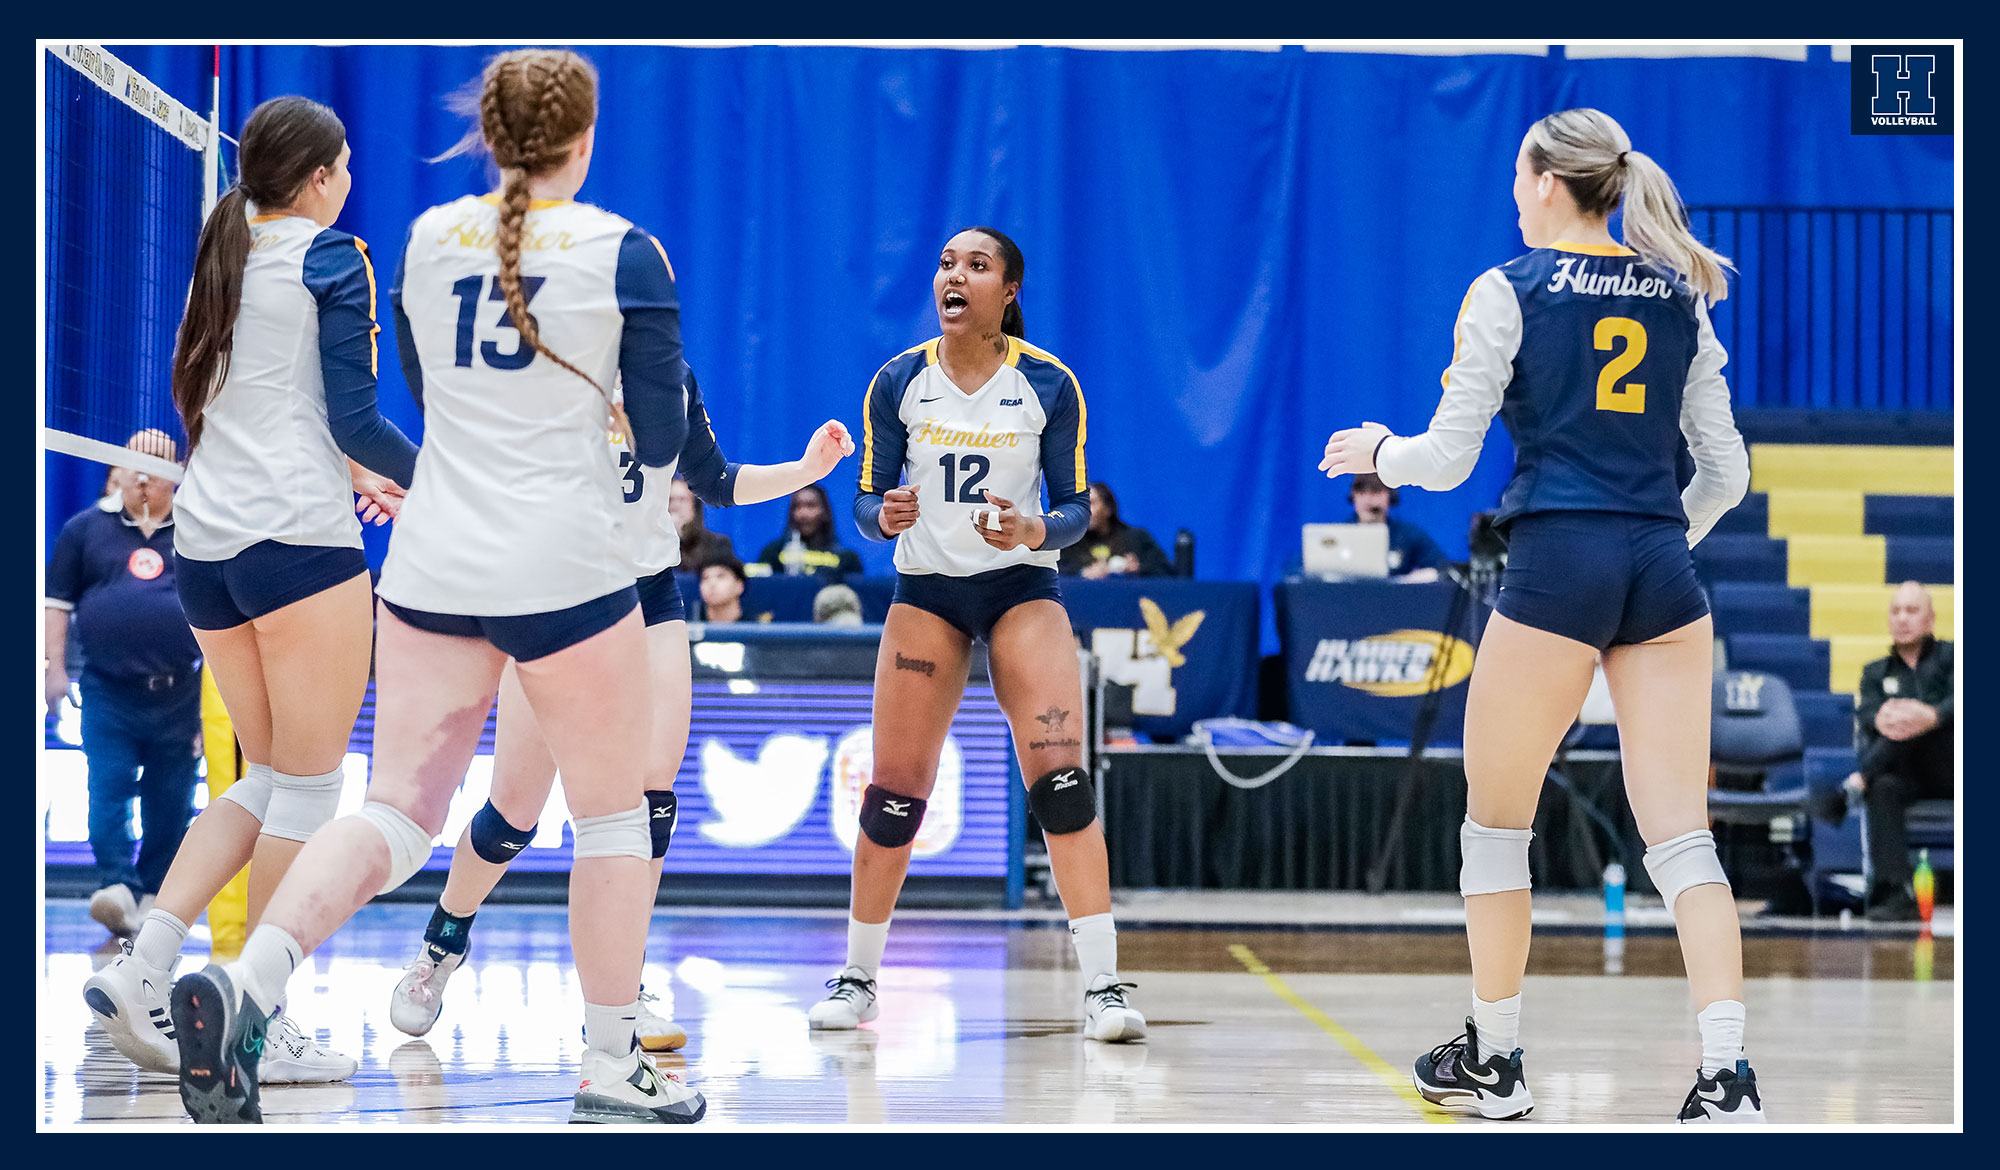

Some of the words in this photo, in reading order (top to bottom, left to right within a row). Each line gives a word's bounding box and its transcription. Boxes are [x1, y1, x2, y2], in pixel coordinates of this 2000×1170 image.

[1547, 257, 1673, 299] Humber
[452, 275, 547, 370] 13
[1593, 316, 1648, 414] 2
[916, 417, 1020, 449] Humber
[939, 452, 991, 504] 12
[1305, 657, 1428, 683] HAWKS
[1314, 638, 1434, 664] HUMBER
